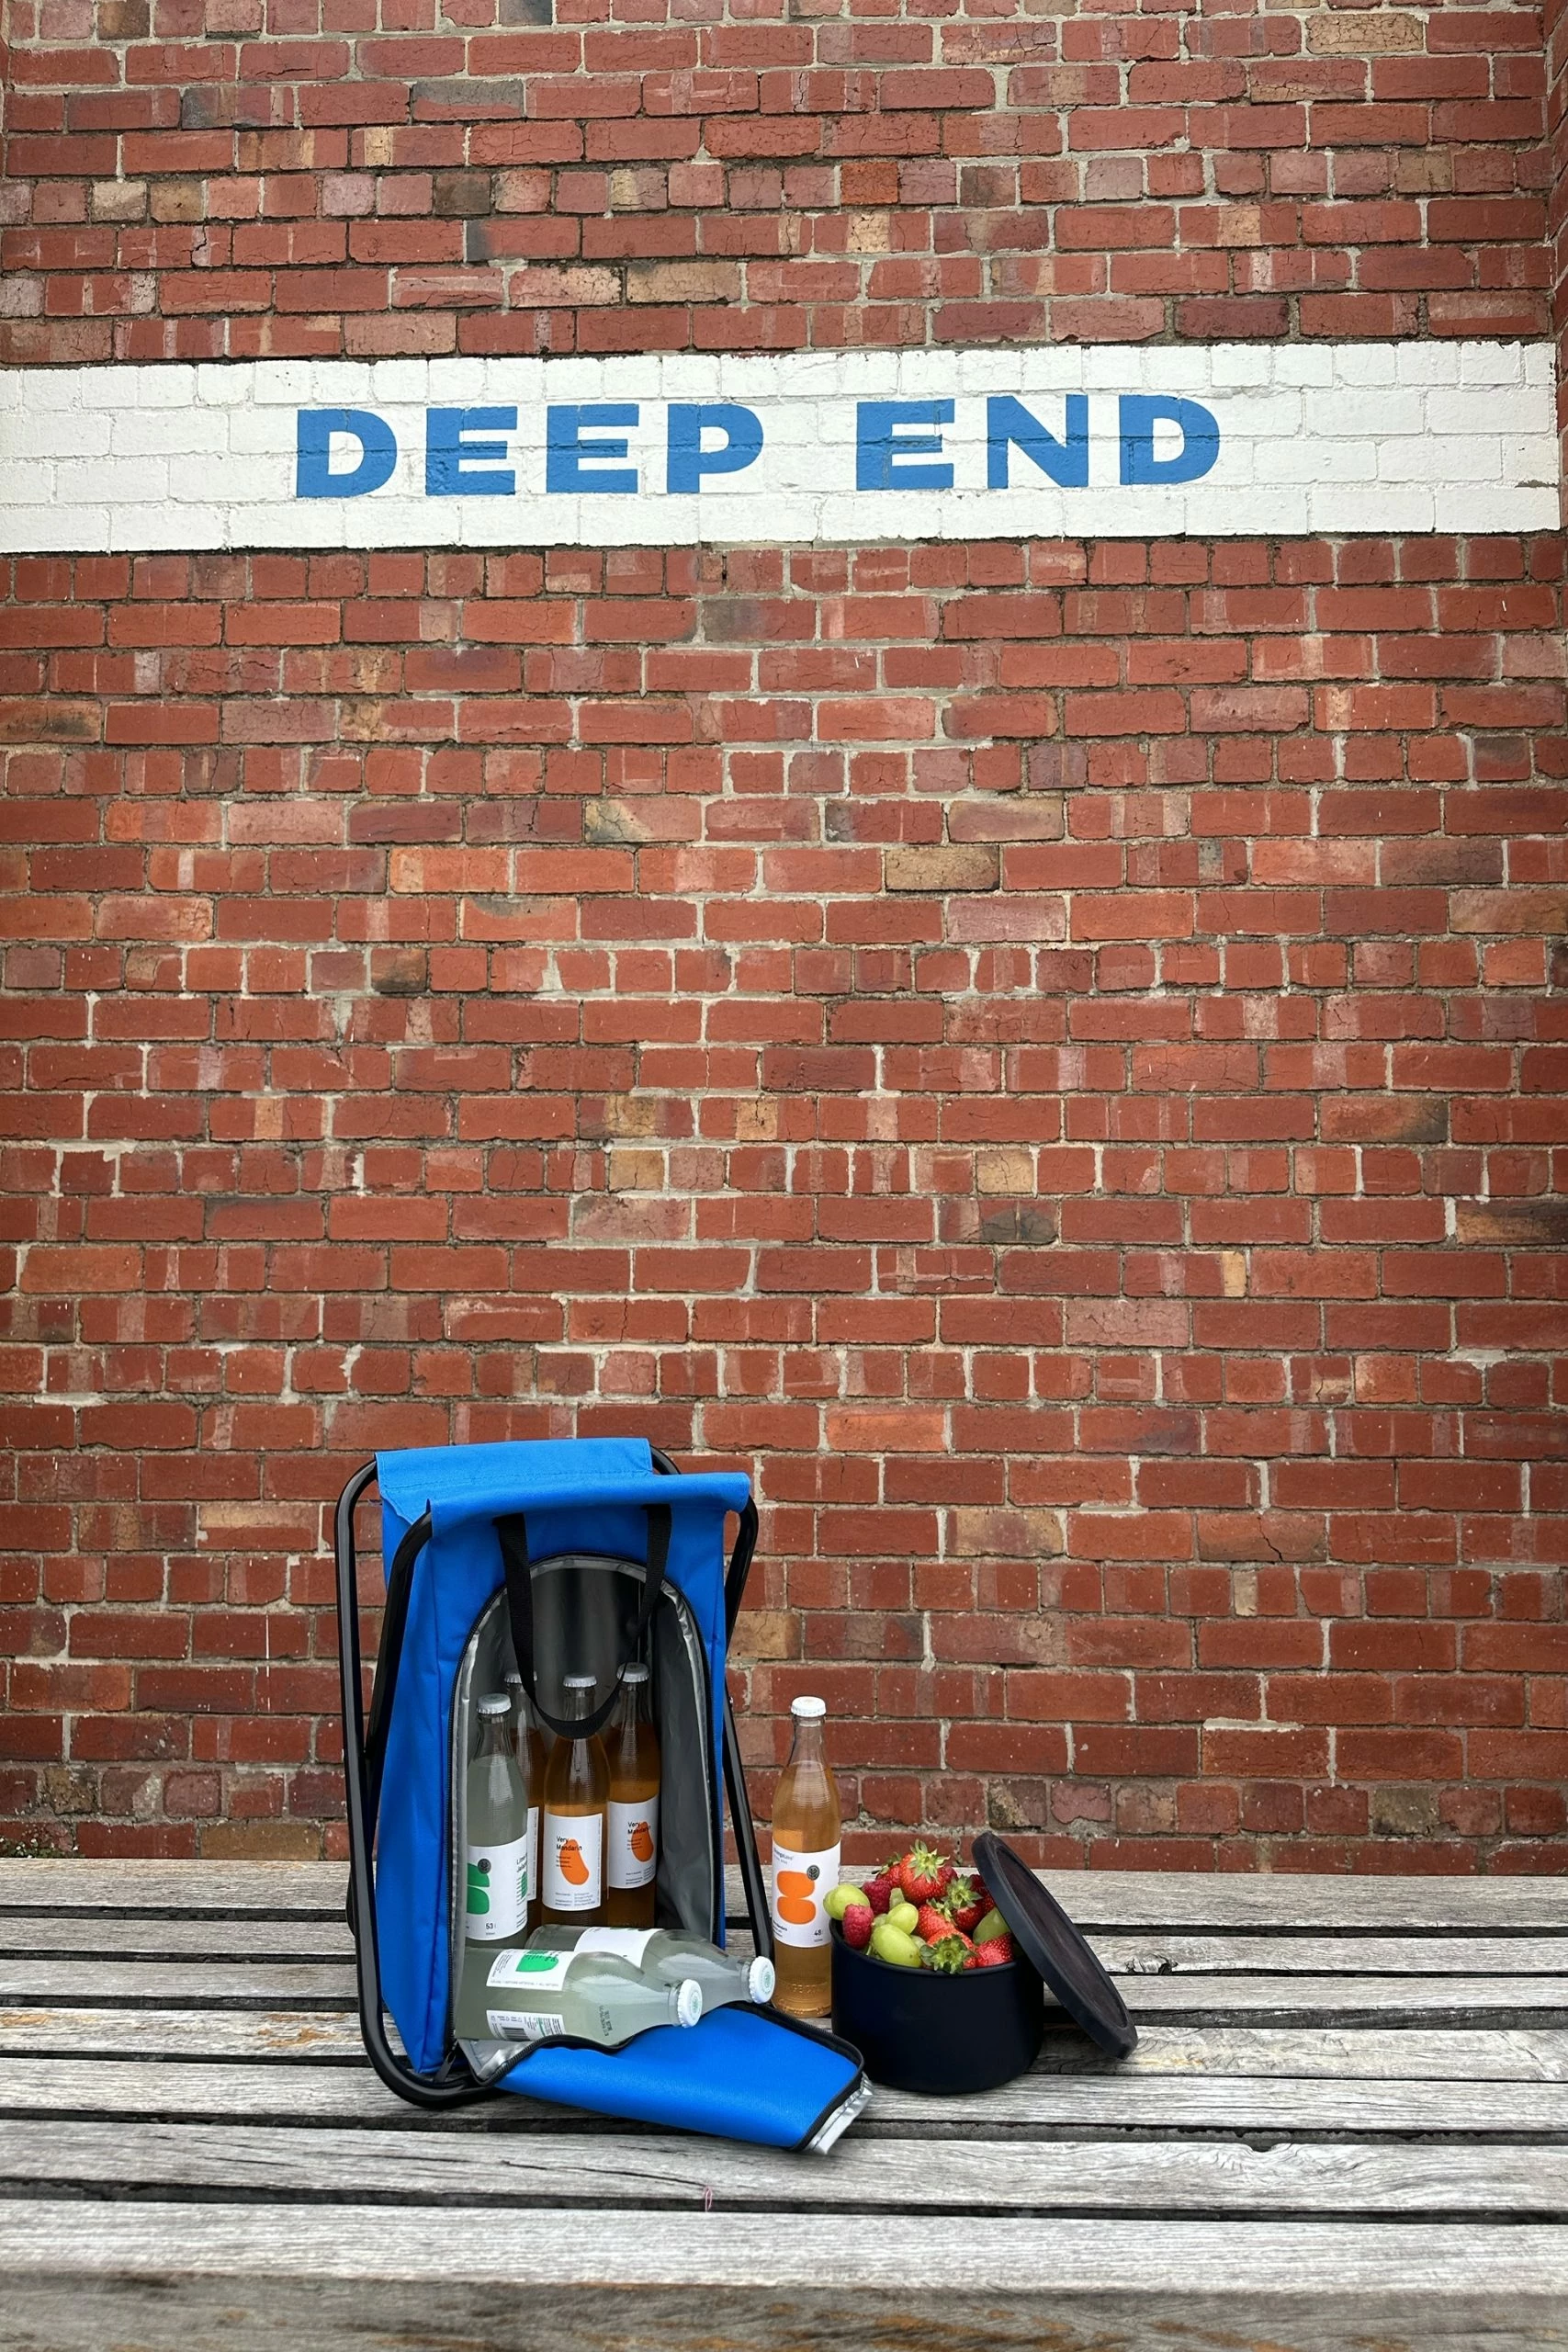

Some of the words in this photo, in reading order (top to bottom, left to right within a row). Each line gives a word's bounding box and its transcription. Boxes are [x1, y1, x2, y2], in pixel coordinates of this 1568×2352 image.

[297, 403, 763, 498] DEEP
[856, 394, 1220, 492] END
[627, 1821, 641, 1830] Very
[556, 1836, 570, 1846] Very
[556, 1843, 582, 1852] Mandarin
